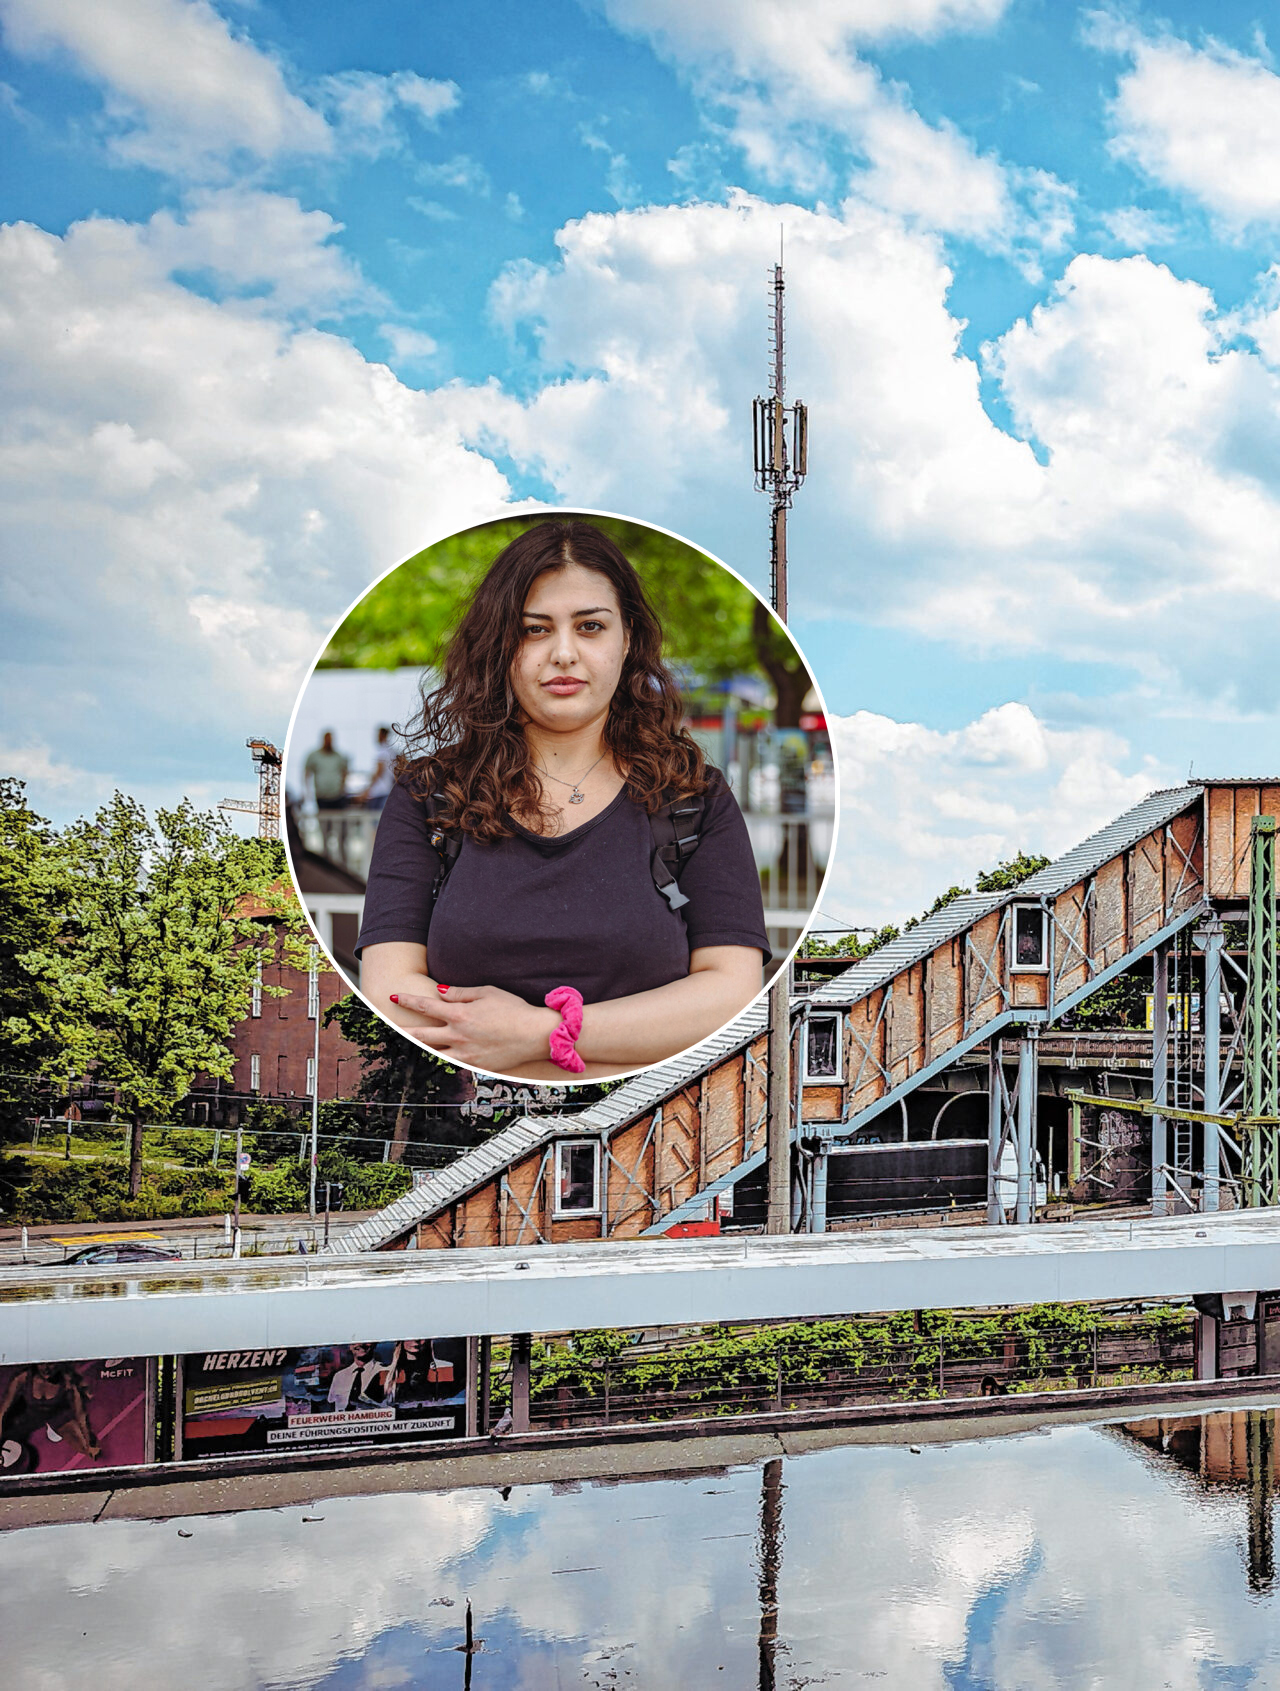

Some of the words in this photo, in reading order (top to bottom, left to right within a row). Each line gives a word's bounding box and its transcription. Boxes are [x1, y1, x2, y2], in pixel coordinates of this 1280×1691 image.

[203, 1350, 287, 1371] HERZEN?
[290, 1413, 346, 1425] FEUERWEHR
[348, 1411, 393, 1421] HAMBURG
[270, 1430, 297, 1441] DEINE
[300, 1424, 391, 1438] FÜHRUNGSPOSITION
[392, 1422, 408, 1431] MIT
[410, 1419, 451, 1430] ZUKUNFT
